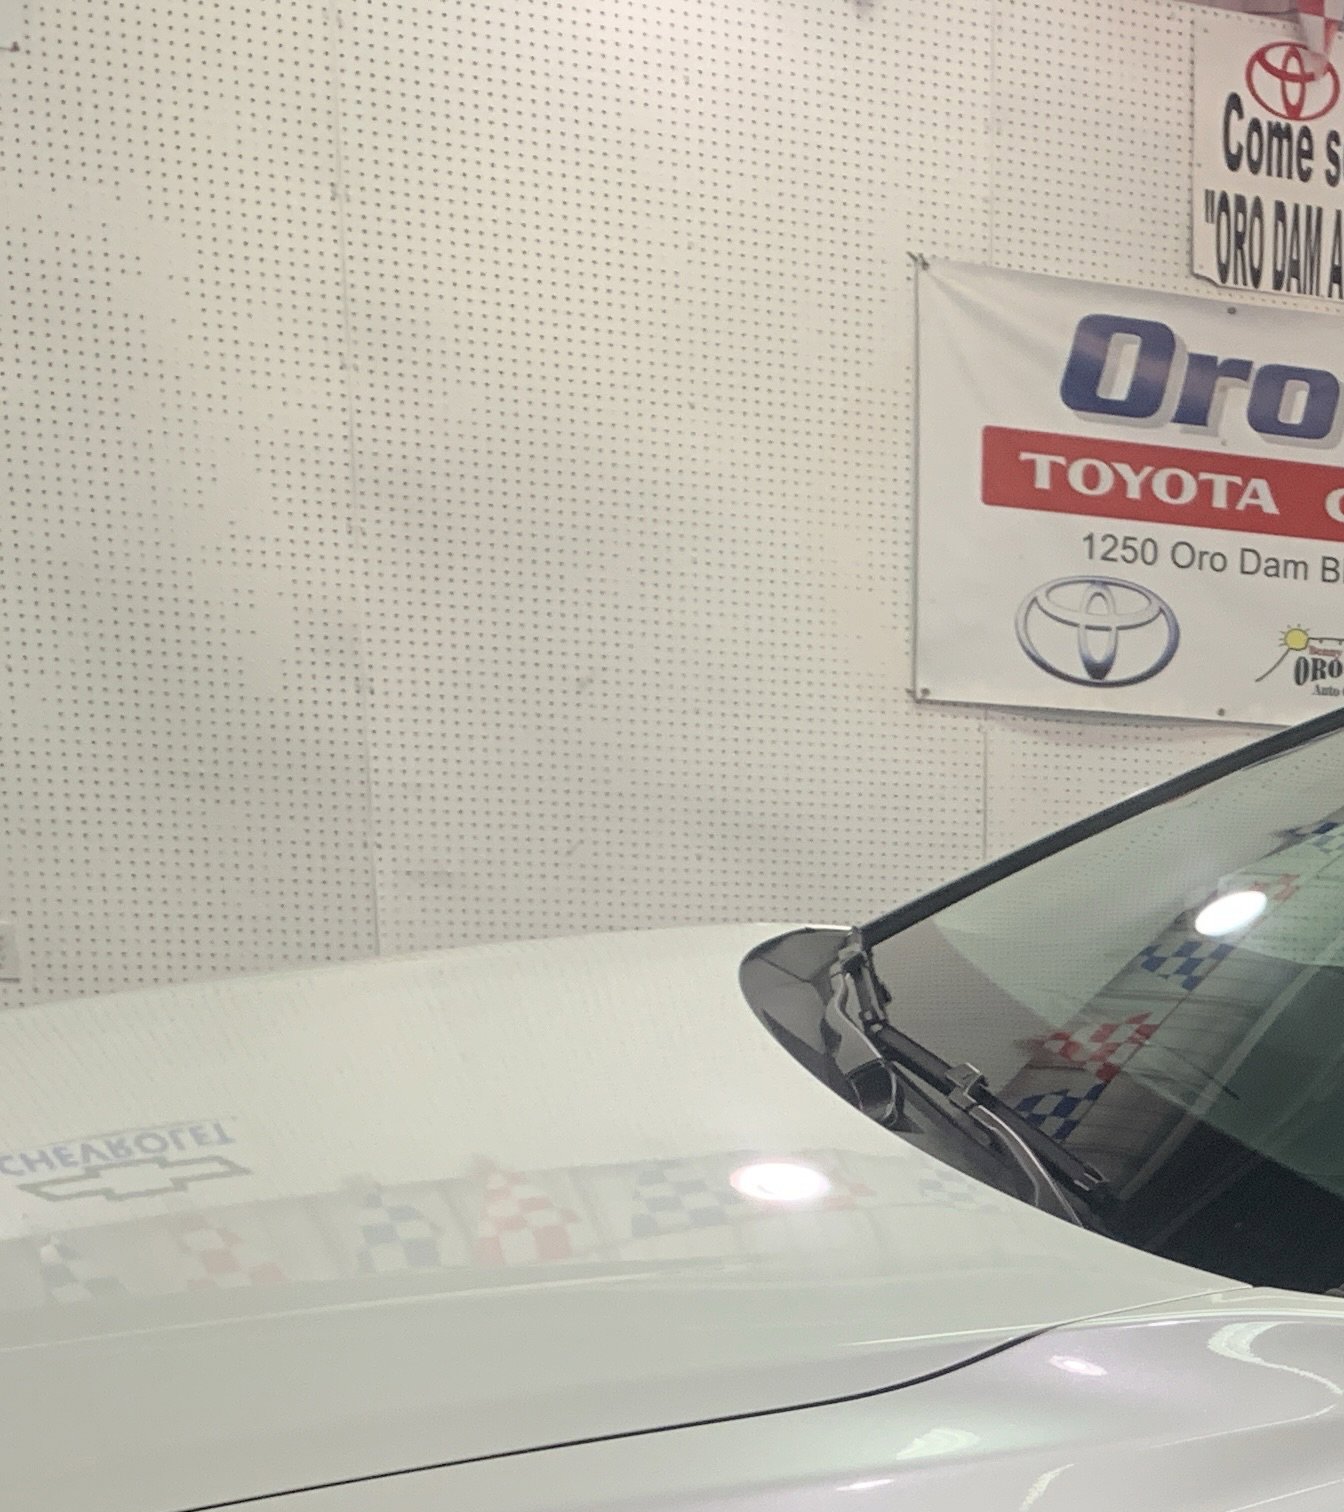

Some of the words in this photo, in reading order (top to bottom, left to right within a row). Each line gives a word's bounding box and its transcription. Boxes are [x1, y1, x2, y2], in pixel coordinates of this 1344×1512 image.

[1223, 92, 1313, 182] Come
[1205, 189, 1264, 288] "ORO
[1273, 200, 1323, 296] DAM
[1019, 451, 1280, 515] TOYOTA
[1081, 531, 1158, 567] 1250
[1171, 540, 1228, 573] Oro
[1239, 547, 1309, 581] Dam
[1294, 656, 1344, 686] ORO
[1312, 685, 1340, 697] Auto
